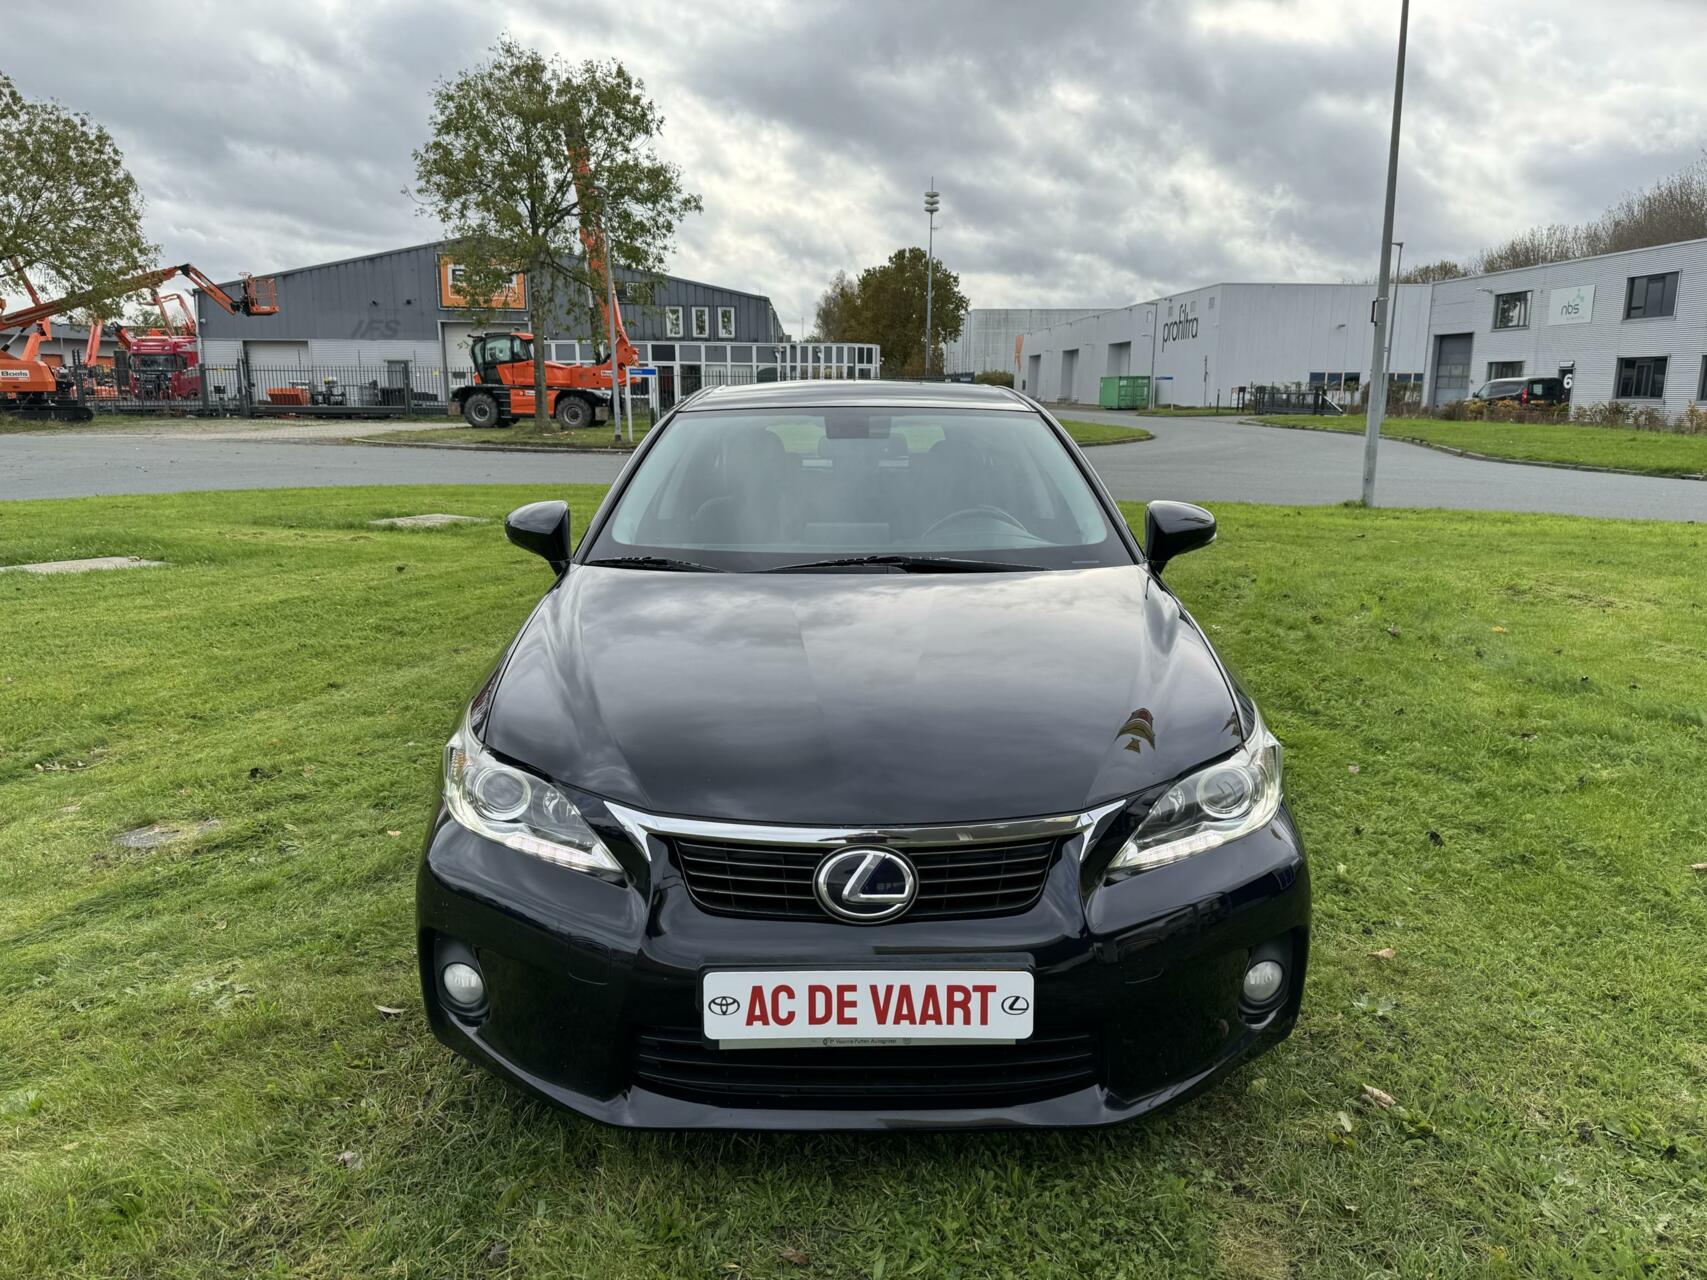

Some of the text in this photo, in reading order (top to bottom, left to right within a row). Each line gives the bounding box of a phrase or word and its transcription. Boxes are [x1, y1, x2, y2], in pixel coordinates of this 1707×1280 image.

[1561, 301, 1579, 315] nbs
[1162, 304, 1198, 352] profiltra
[1563, 373, 1573, 389] 6
[745, 984, 997, 1027] AC DE VAART
